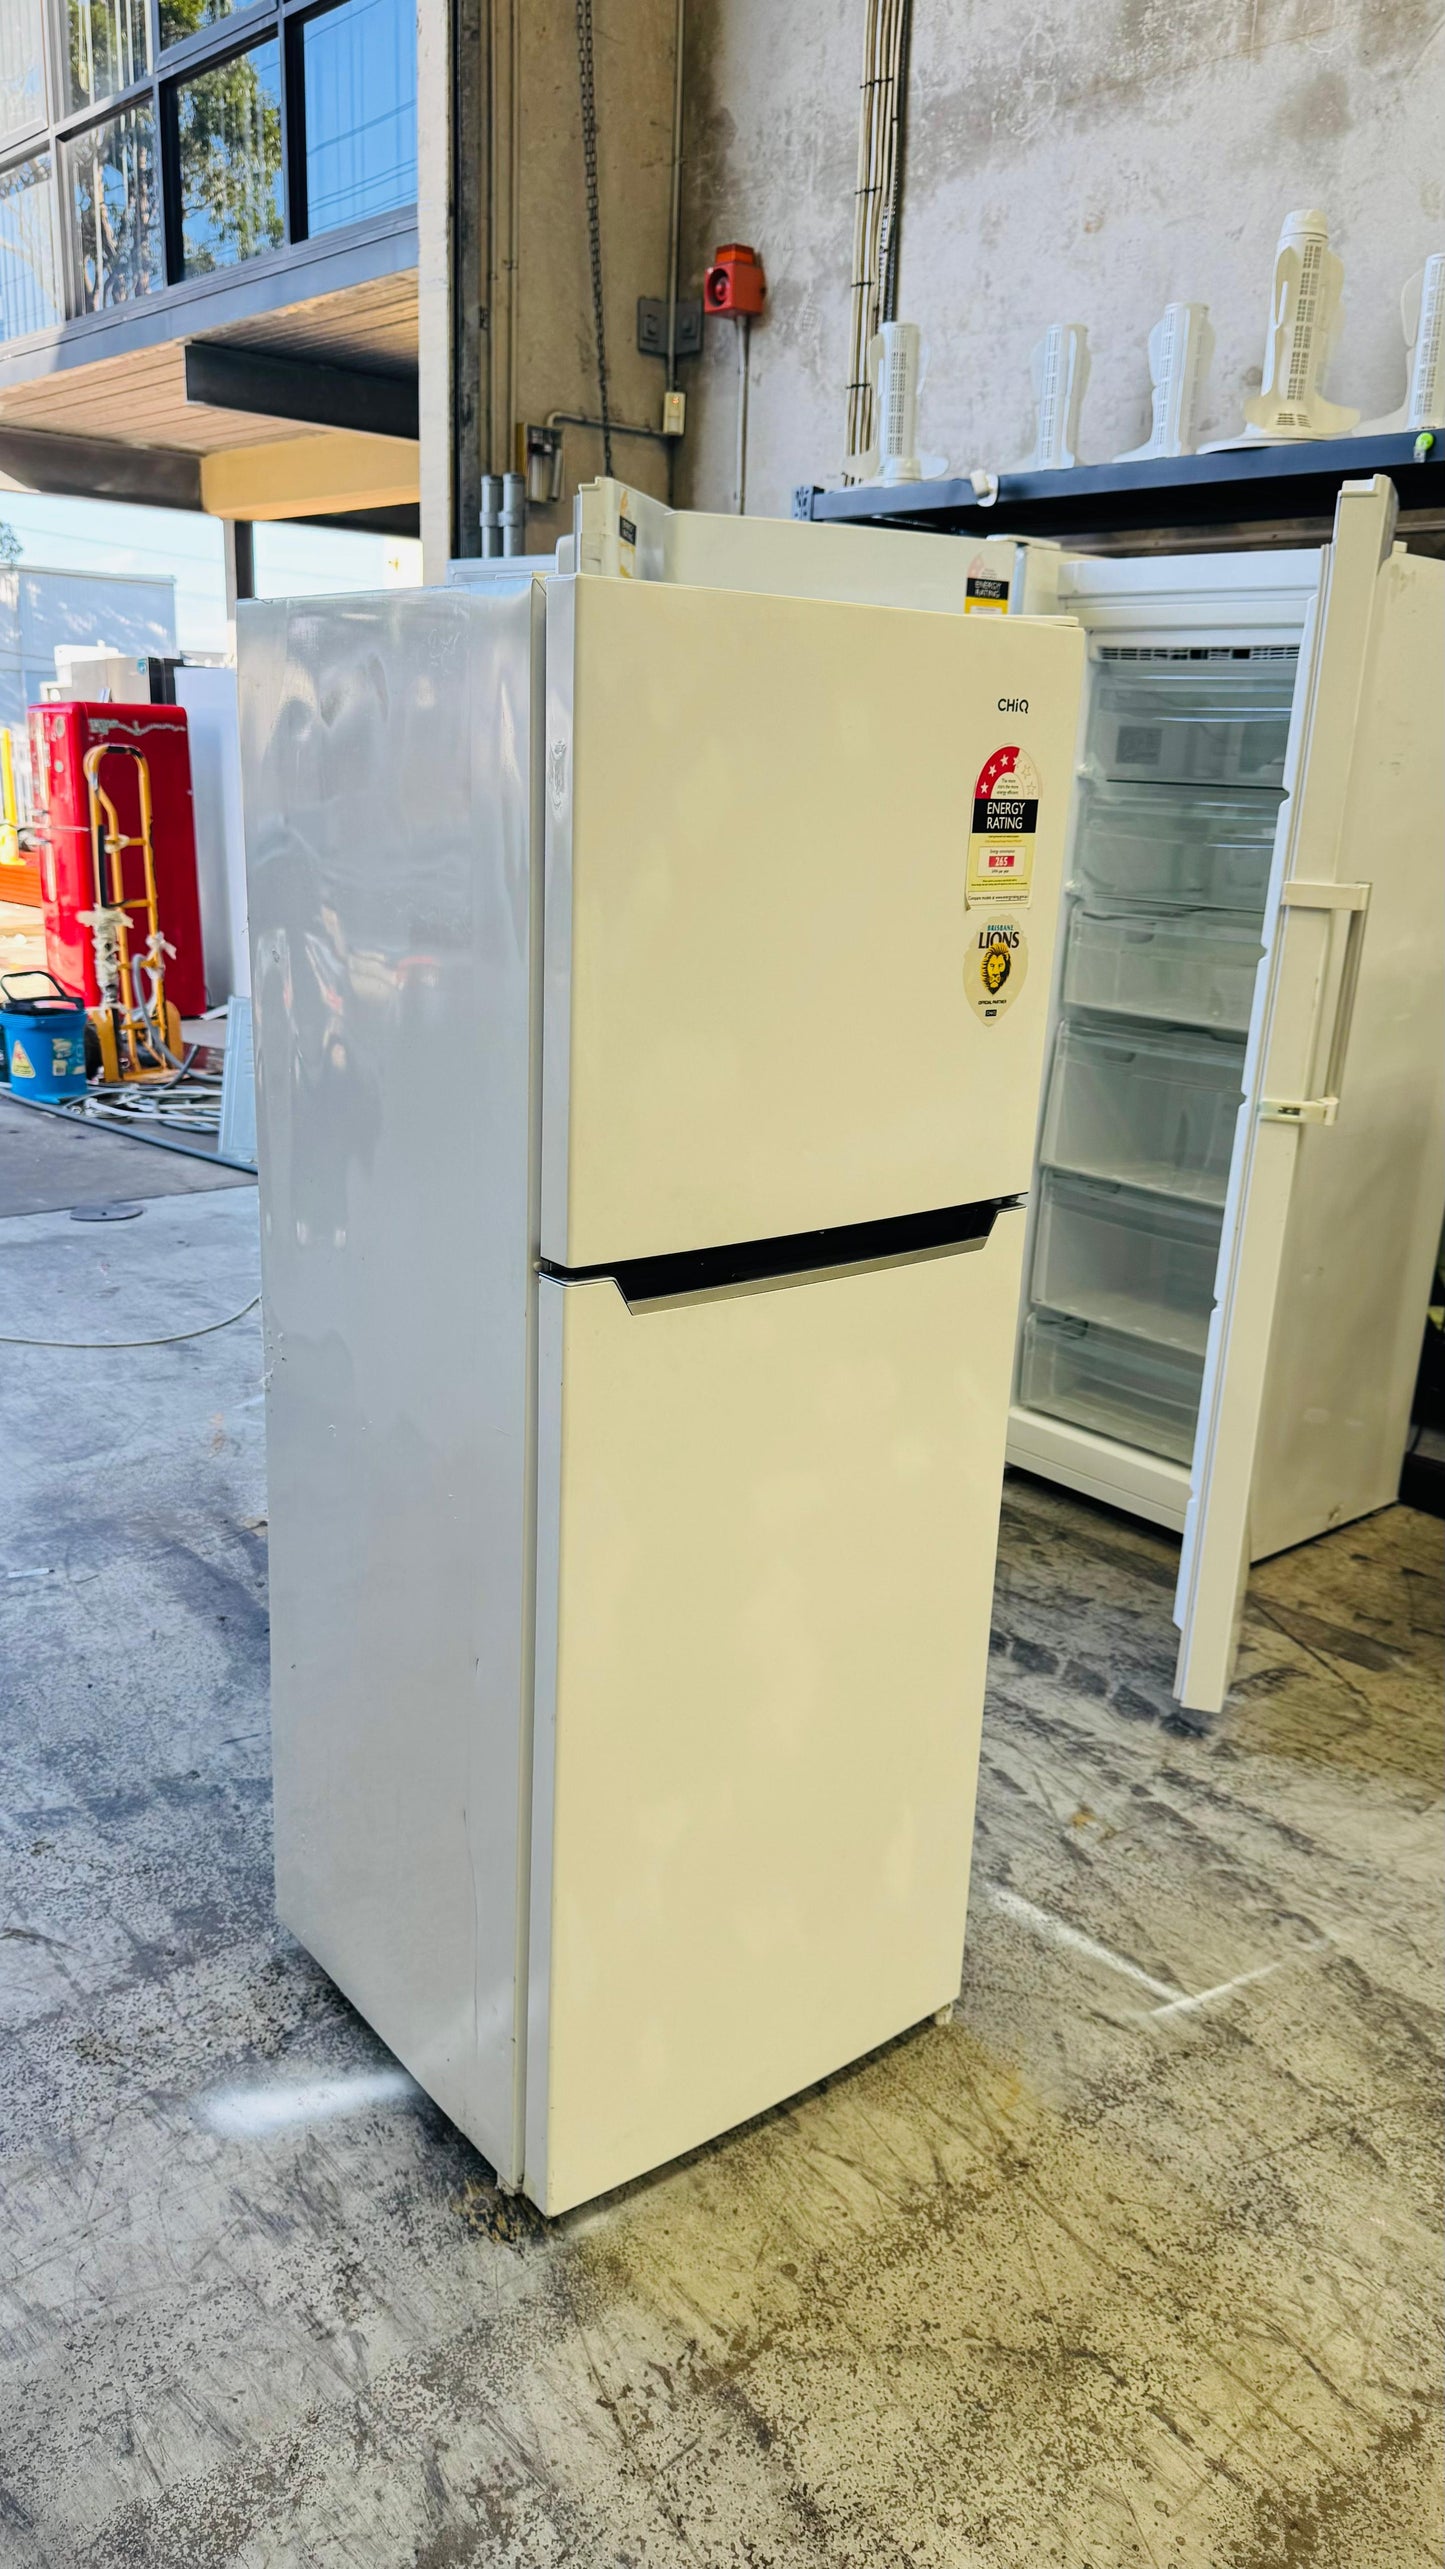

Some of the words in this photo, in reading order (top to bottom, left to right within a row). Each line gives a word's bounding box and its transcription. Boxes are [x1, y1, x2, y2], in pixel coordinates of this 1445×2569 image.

[997, 698, 1029, 714] CHiQ
[986, 802, 1026, 815] ENERGY
[986, 817, 1023, 830] RATING
[995, 856, 1008, 866] 265
[978, 931, 1020, 949] LIONS
